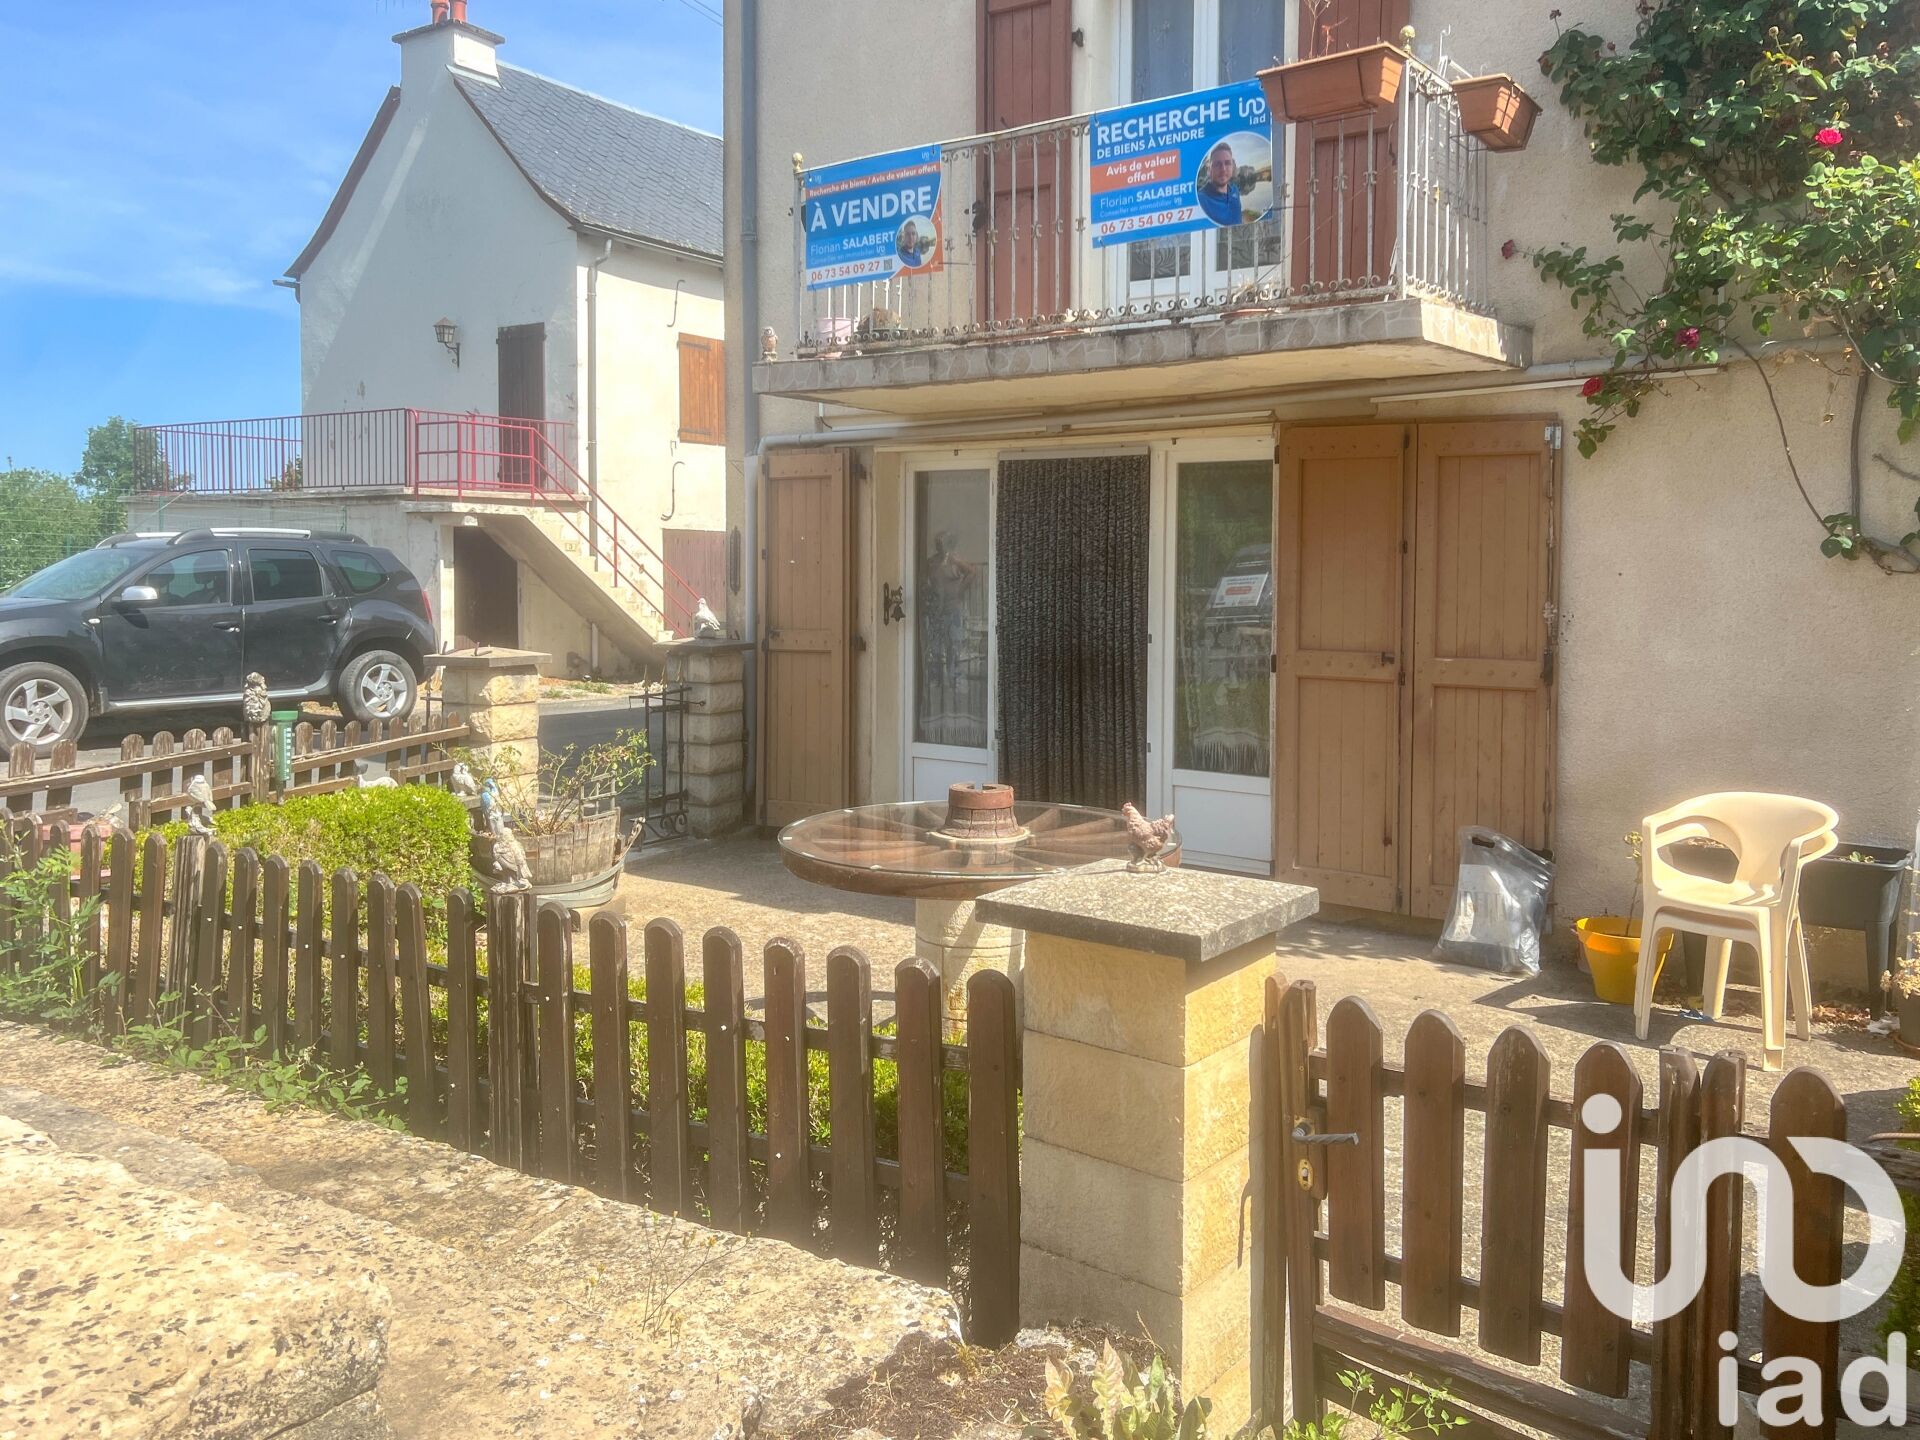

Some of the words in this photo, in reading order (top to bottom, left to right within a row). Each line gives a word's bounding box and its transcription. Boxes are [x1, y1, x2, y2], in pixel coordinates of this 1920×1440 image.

[1097, 98, 1230, 146] RECHERCHE
[1249, 112, 1266, 126] iad
[1096, 146, 1111, 159] DE
[1113, 139, 1146, 156] BIENS
[1147, 135, 1156, 149] À
[1158, 127, 1205, 146] VENDRE
[1106, 163, 1127, 176] Avis
[1129, 160, 1142, 171] de
[1144, 155, 1177, 168] valeur
[1127, 170, 1155, 184] offert
[809, 184, 840, 197] Recherche
[840, 181, 849, 190] de
[871, 175, 886, 184] Avis
[886, 173, 895, 181] de
[895, 169, 917, 179] valeur
[917, 164, 937, 174] offert
[1100, 194, 1134, 209] Florian
[1136, 181, 1194, 202] SALABERT
[810, 201, 827, 233] À
[831, 185, 932, 228] VENDRE
[1101, 222, 1116, 234] 06
[1119, 218, 1134, 231] 73
[1138, 215, 1154, 228] 54
[1157, 211, 1173, 224] 09
[1177, 207, 1194, 220] 27
[811, 242, 841, 257] Florian
[842, 231, 896, 250] SALABERT
[811, 271, 823, 281] 06
[825, 268, 837, 279] 73
[839, 265, 850, 276] 54
[853, 263, 865, 274] 09
[868, 260, 880, 271] 27
